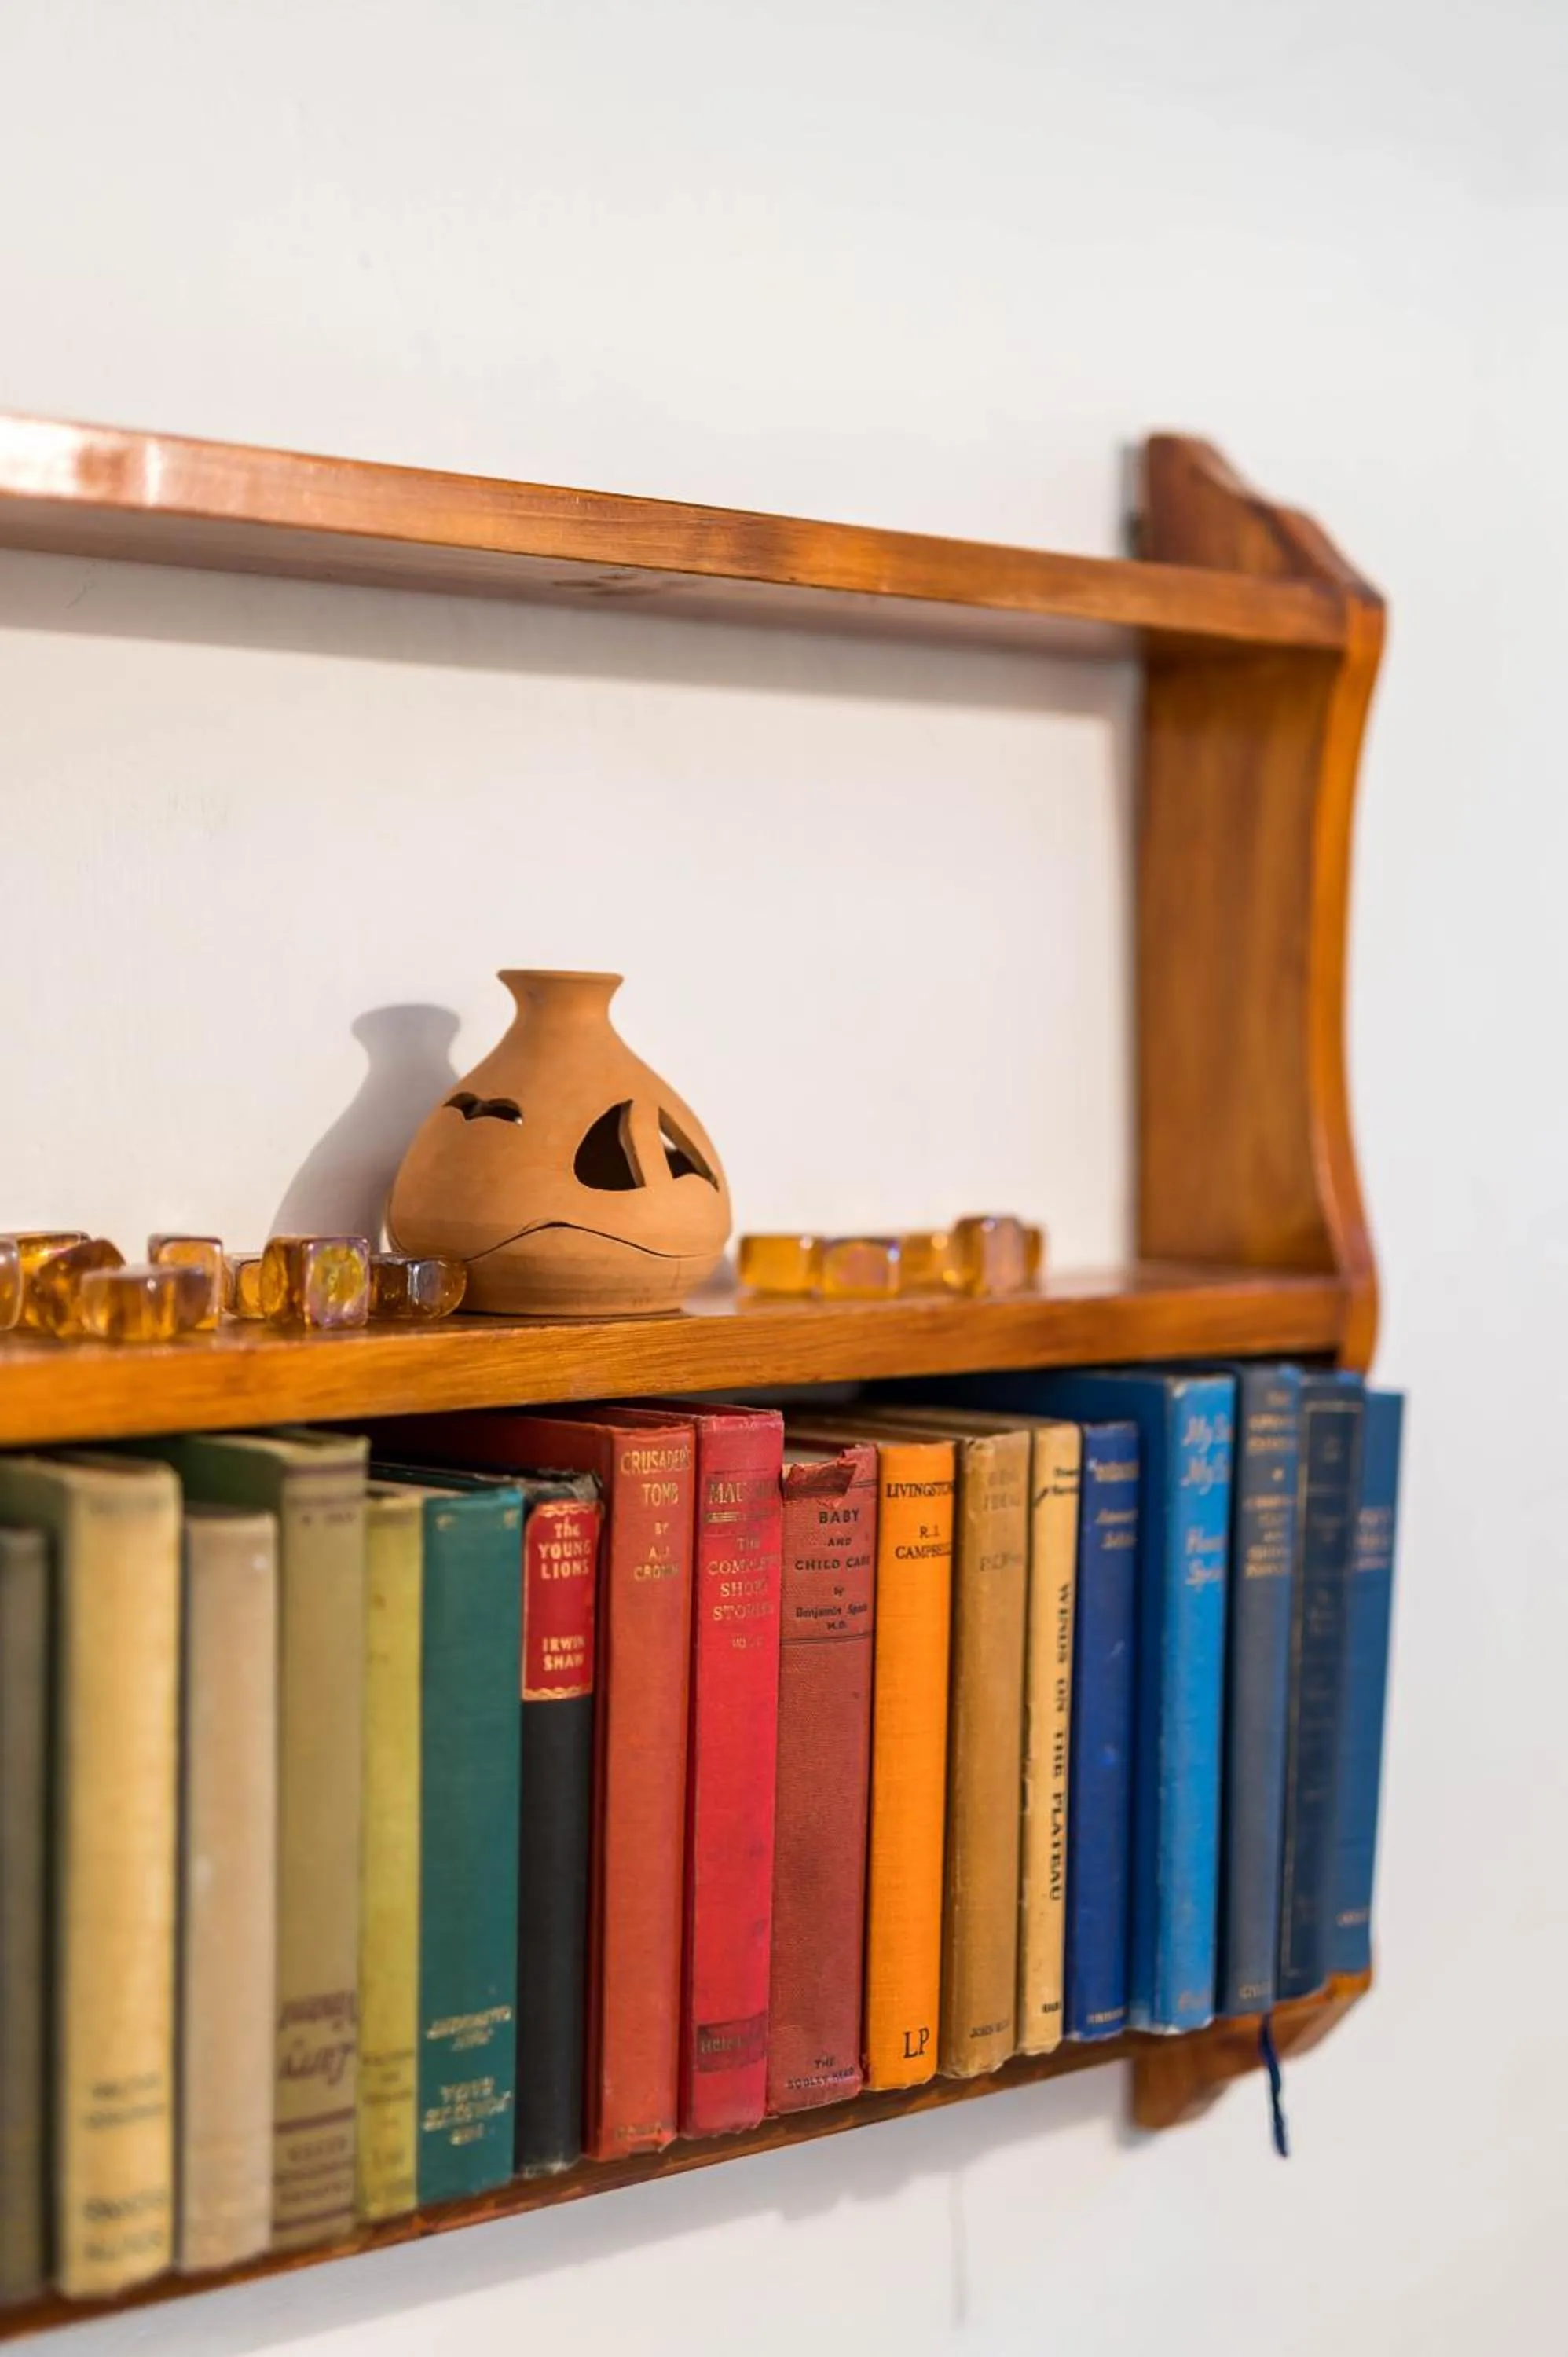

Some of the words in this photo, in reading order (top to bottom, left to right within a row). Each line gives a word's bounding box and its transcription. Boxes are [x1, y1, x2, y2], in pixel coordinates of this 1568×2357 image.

[641, 1483, 680, 1508] TOMB
[819, 1508, 860, 1524] BABY
[554, 1516, 581, 1538] The
[538, 1541, 592, 1560] YOUNG
[827, 1538, 852, 1547] AND
[540, 1560, 590, 1581] LIONS
[794, 1559, 841, 1571] CHILD
[542, 1635, 585, 1652] IRWIN
[543, 1654, 584, 1672] SHAW
[1049, 1791, 1064, 1901] PLATEAU
[903, 2026, 930, 2059] LP
